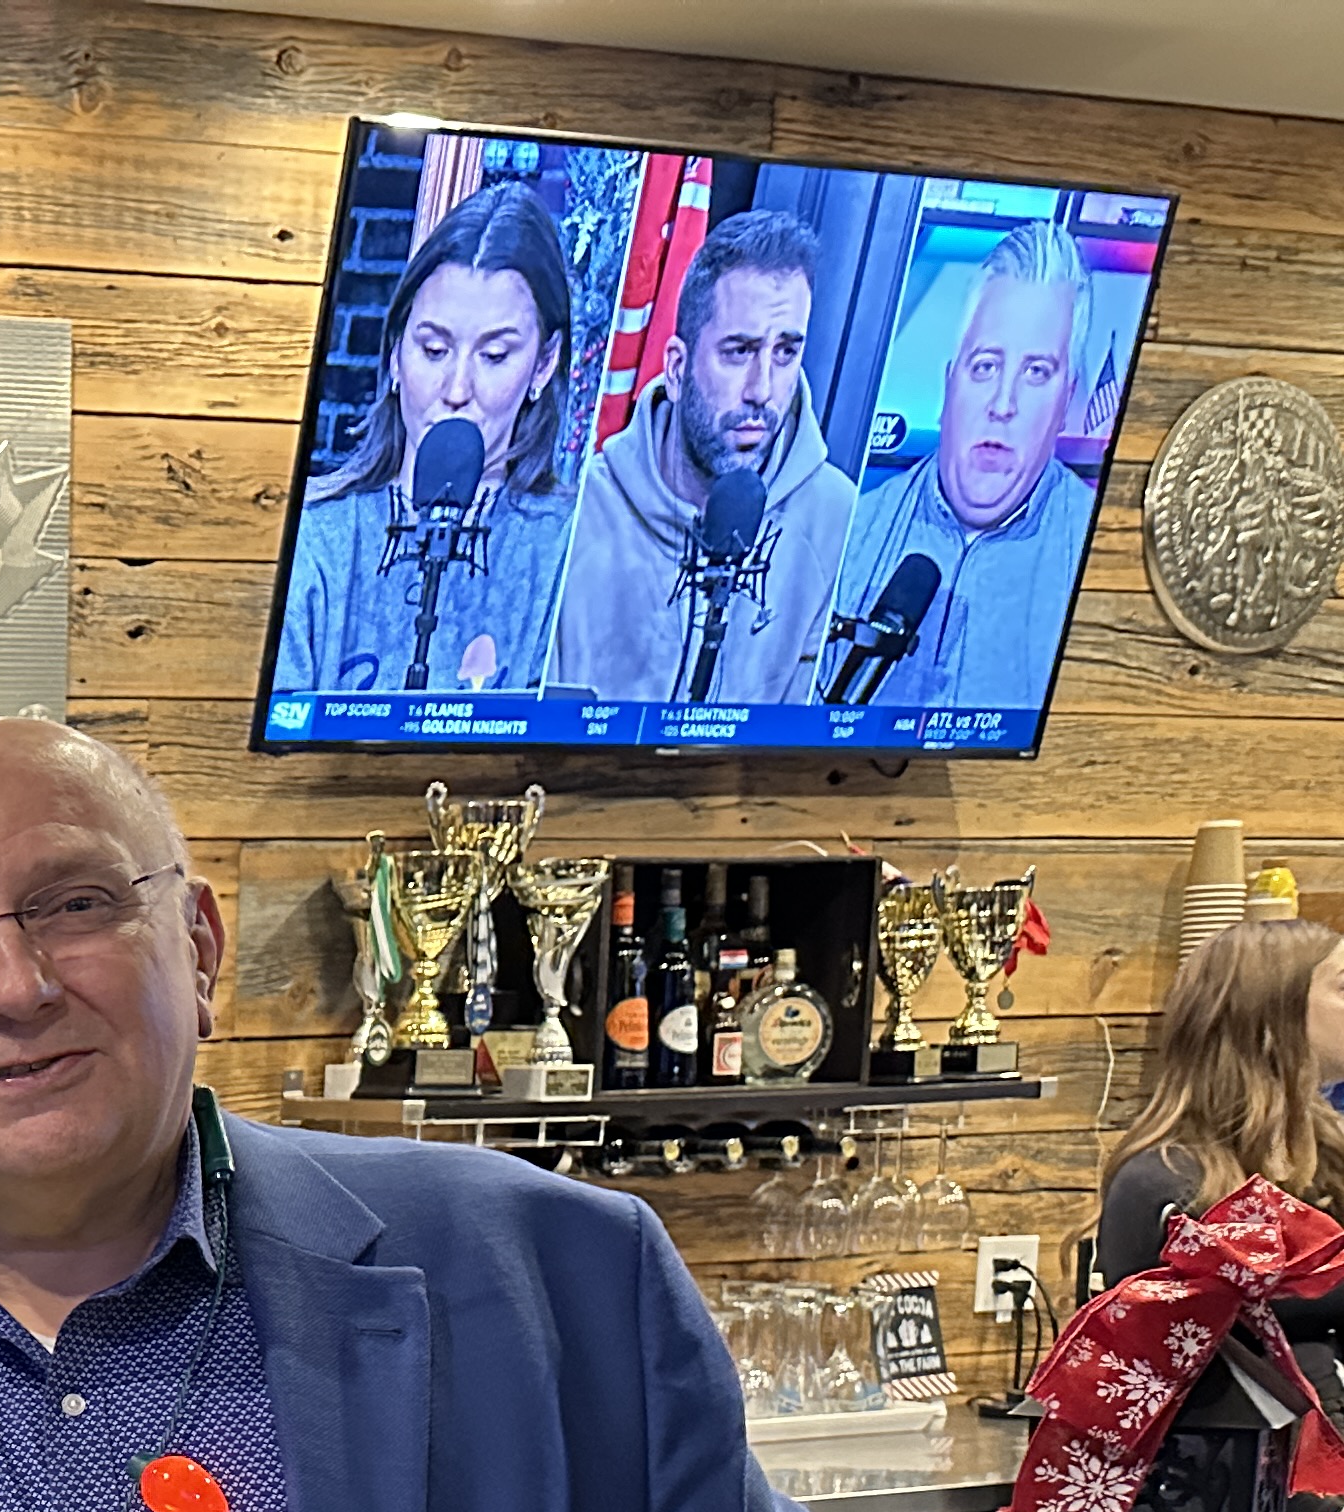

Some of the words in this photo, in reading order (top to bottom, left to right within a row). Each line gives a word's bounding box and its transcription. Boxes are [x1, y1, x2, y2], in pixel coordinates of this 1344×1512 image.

[325, 703, 348, 717] TOP
[347, 703, 392, 717] SCORES
[424, 702, 474, 718] FLAMES
[683, 707, 750, 722] LIGHTNING
[421, 719, 471, 735] GOLDEN
[472, 720, 528, 735] KNIGHTS
[926, 711, 954, 729] ATL
[955, 715, 972, 729] vs
[973, 712, 1003, 730] TOR
[680, 723, 737, 738] CANUCKS
